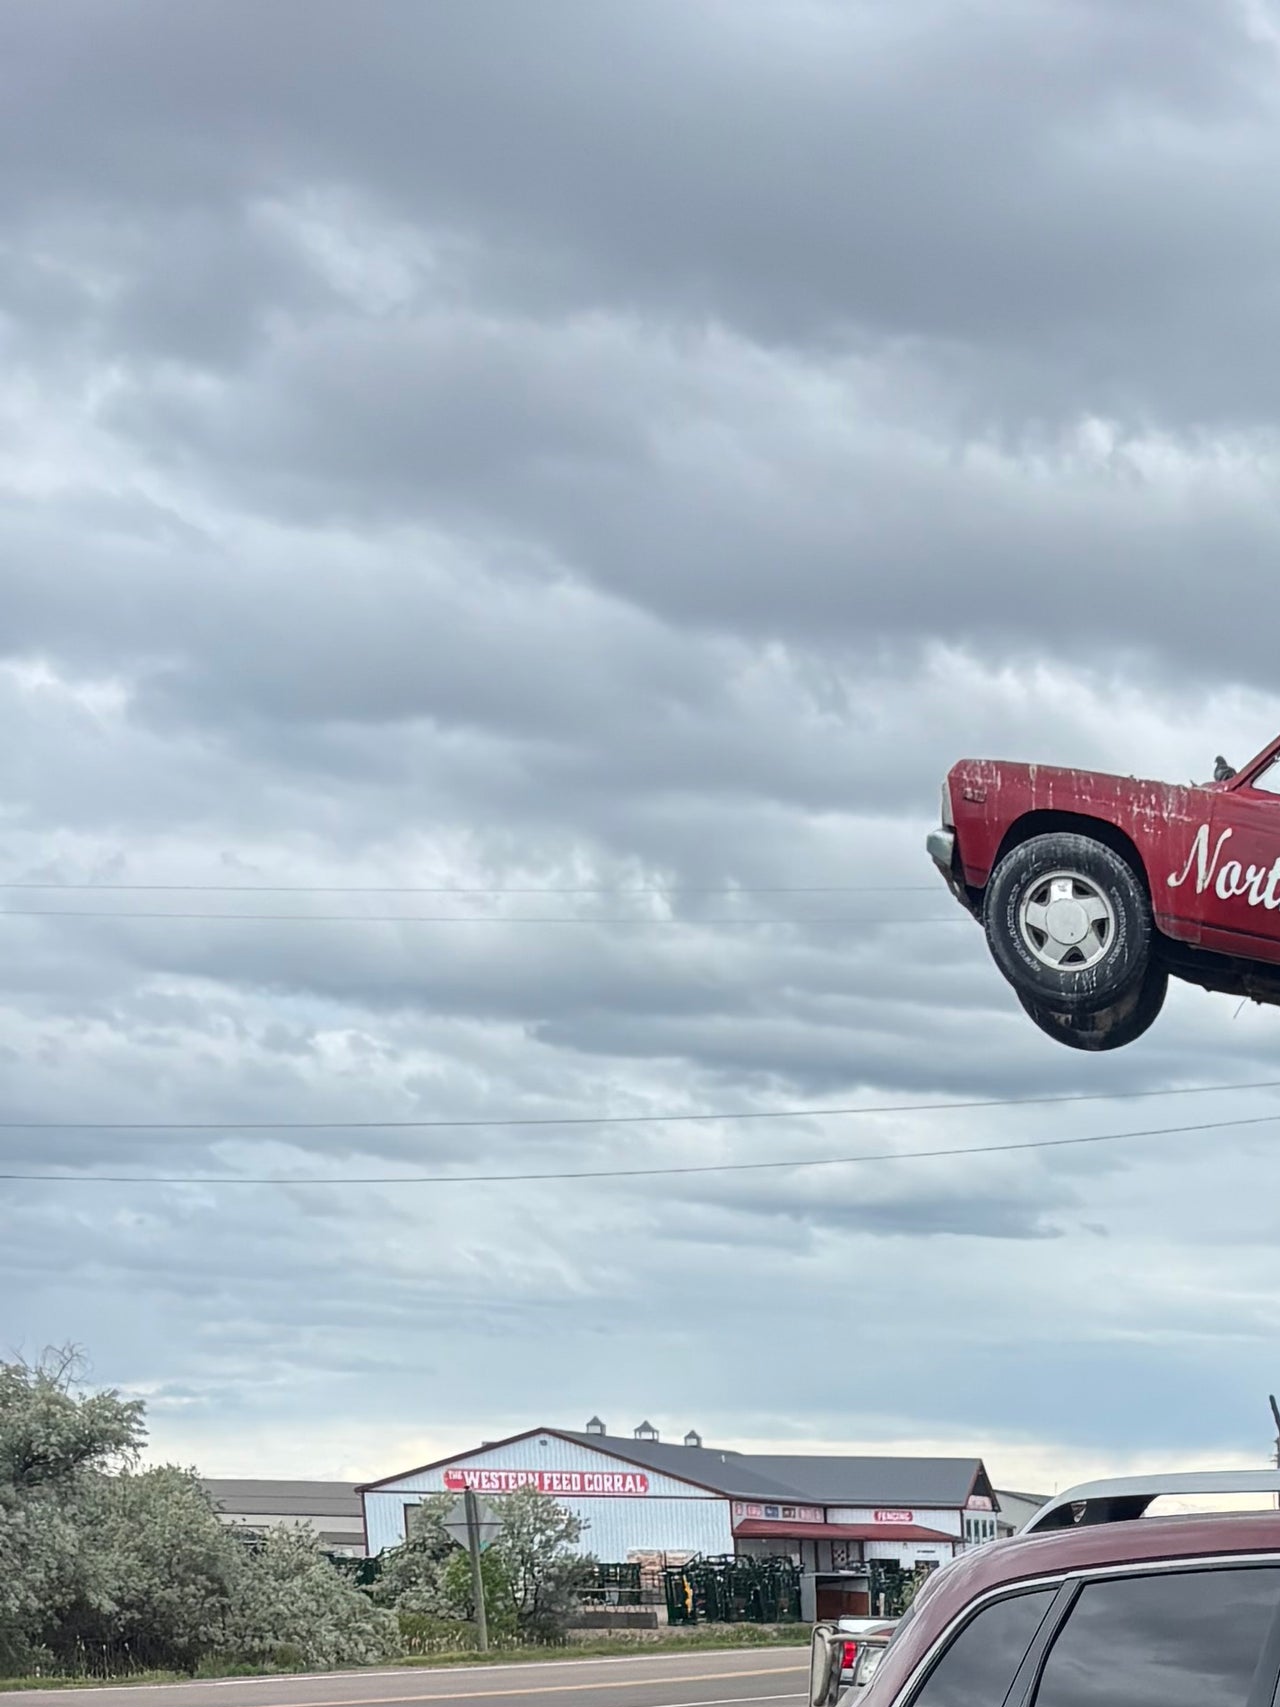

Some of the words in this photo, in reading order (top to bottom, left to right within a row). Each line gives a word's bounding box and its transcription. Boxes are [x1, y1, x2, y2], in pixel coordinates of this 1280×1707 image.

[463, 1471, 539, 1490] WESTERN
[543, 1473, 581, 1491] FEED
[584, 1473, 645, 1493] CORRAL
[877, 1510, 910, 1521] FENCING
